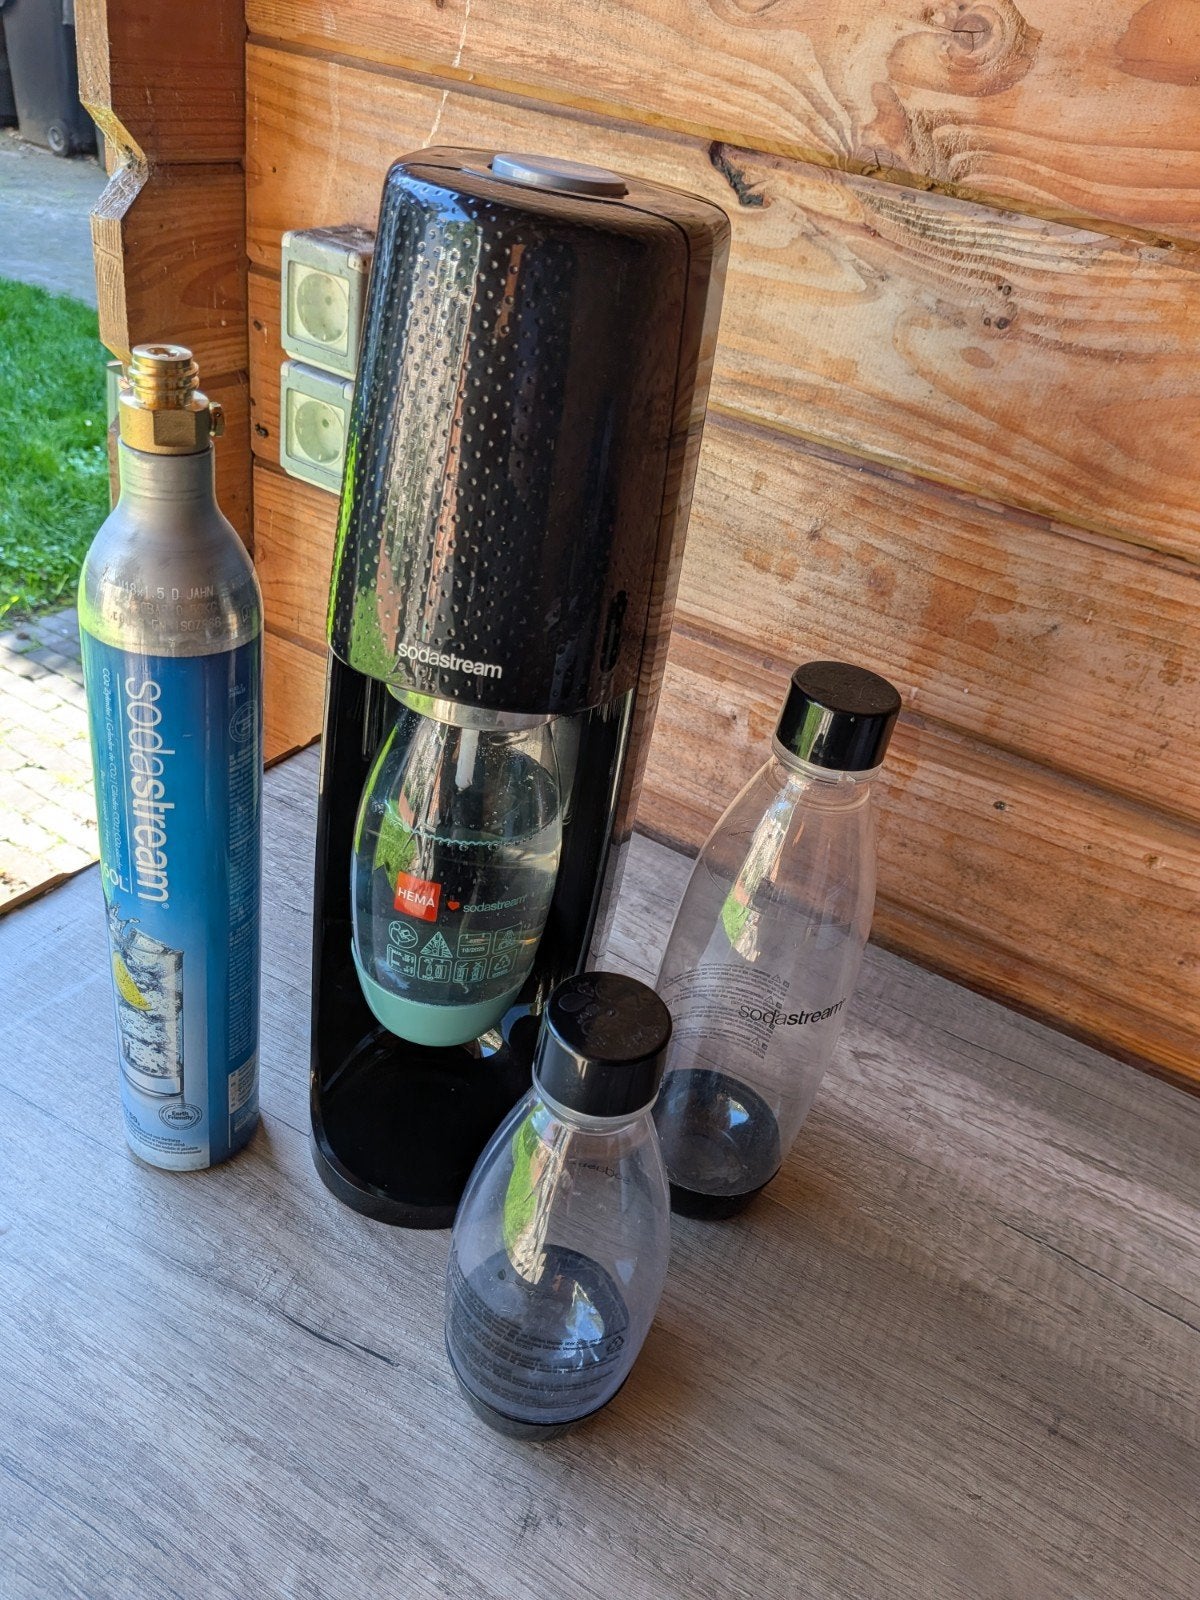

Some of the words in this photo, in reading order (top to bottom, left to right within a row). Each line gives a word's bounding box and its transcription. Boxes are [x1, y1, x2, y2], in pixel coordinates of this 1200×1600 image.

[187, 585, 214, 600] JAHN
[397, 642, 503, 679] sodastream
[124, 676, 175, 902] sodastream
[397, 886, 435, 908] HEMA
[463, 894, 526, 913] sodastream
[738, 998, 845, 1026] sodastream
